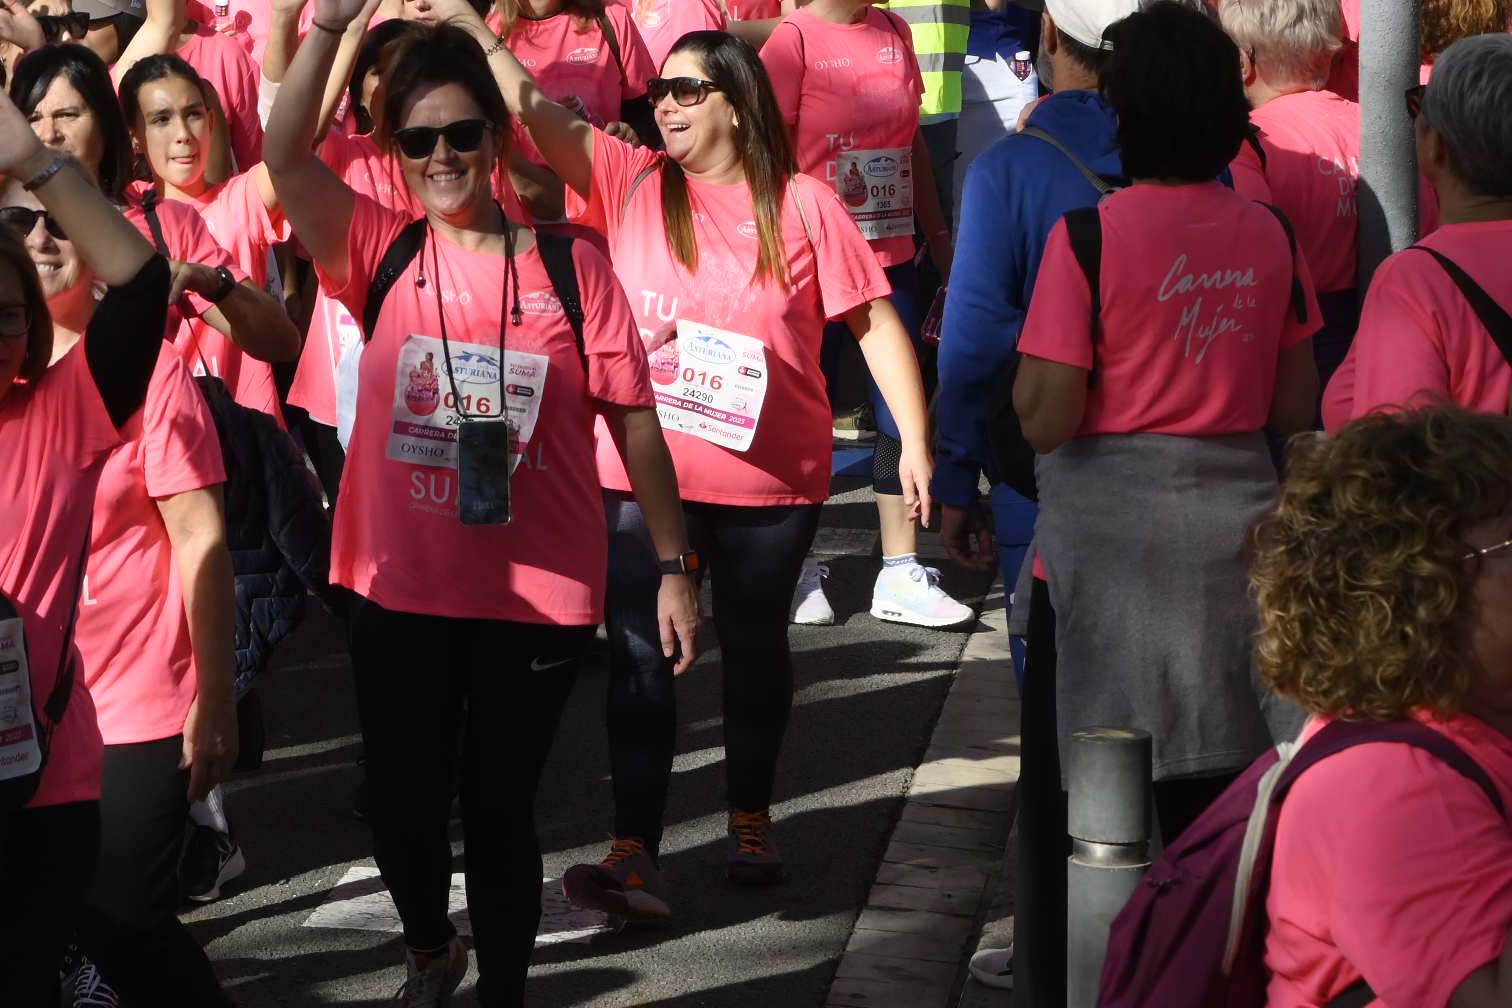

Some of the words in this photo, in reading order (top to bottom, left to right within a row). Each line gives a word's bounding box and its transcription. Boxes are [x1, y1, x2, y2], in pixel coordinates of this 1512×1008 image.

[825, 131, 855, 152] TU
[870, 184, 896, 198] 016
[1156, 253, 1257, 302] Carrera
[641, 289, 678, 321] TU
[1174, 296, 1242, 365] Mujer
[508, 367, 537, 378] SUMA
[682, 367, 724, 390] 016
[682, 387, 714, 404] 24290
[658, 409, 681, 422] SHO
[683, 401, 694, 410] DE
[694, 404, 704, 413] LA
[703, 406, 727, 421] MUJER
[707, 424, 745, 442] Santander
[400, 442, 445, 458] OYSHO
[409, 469, 451, 504] SU
